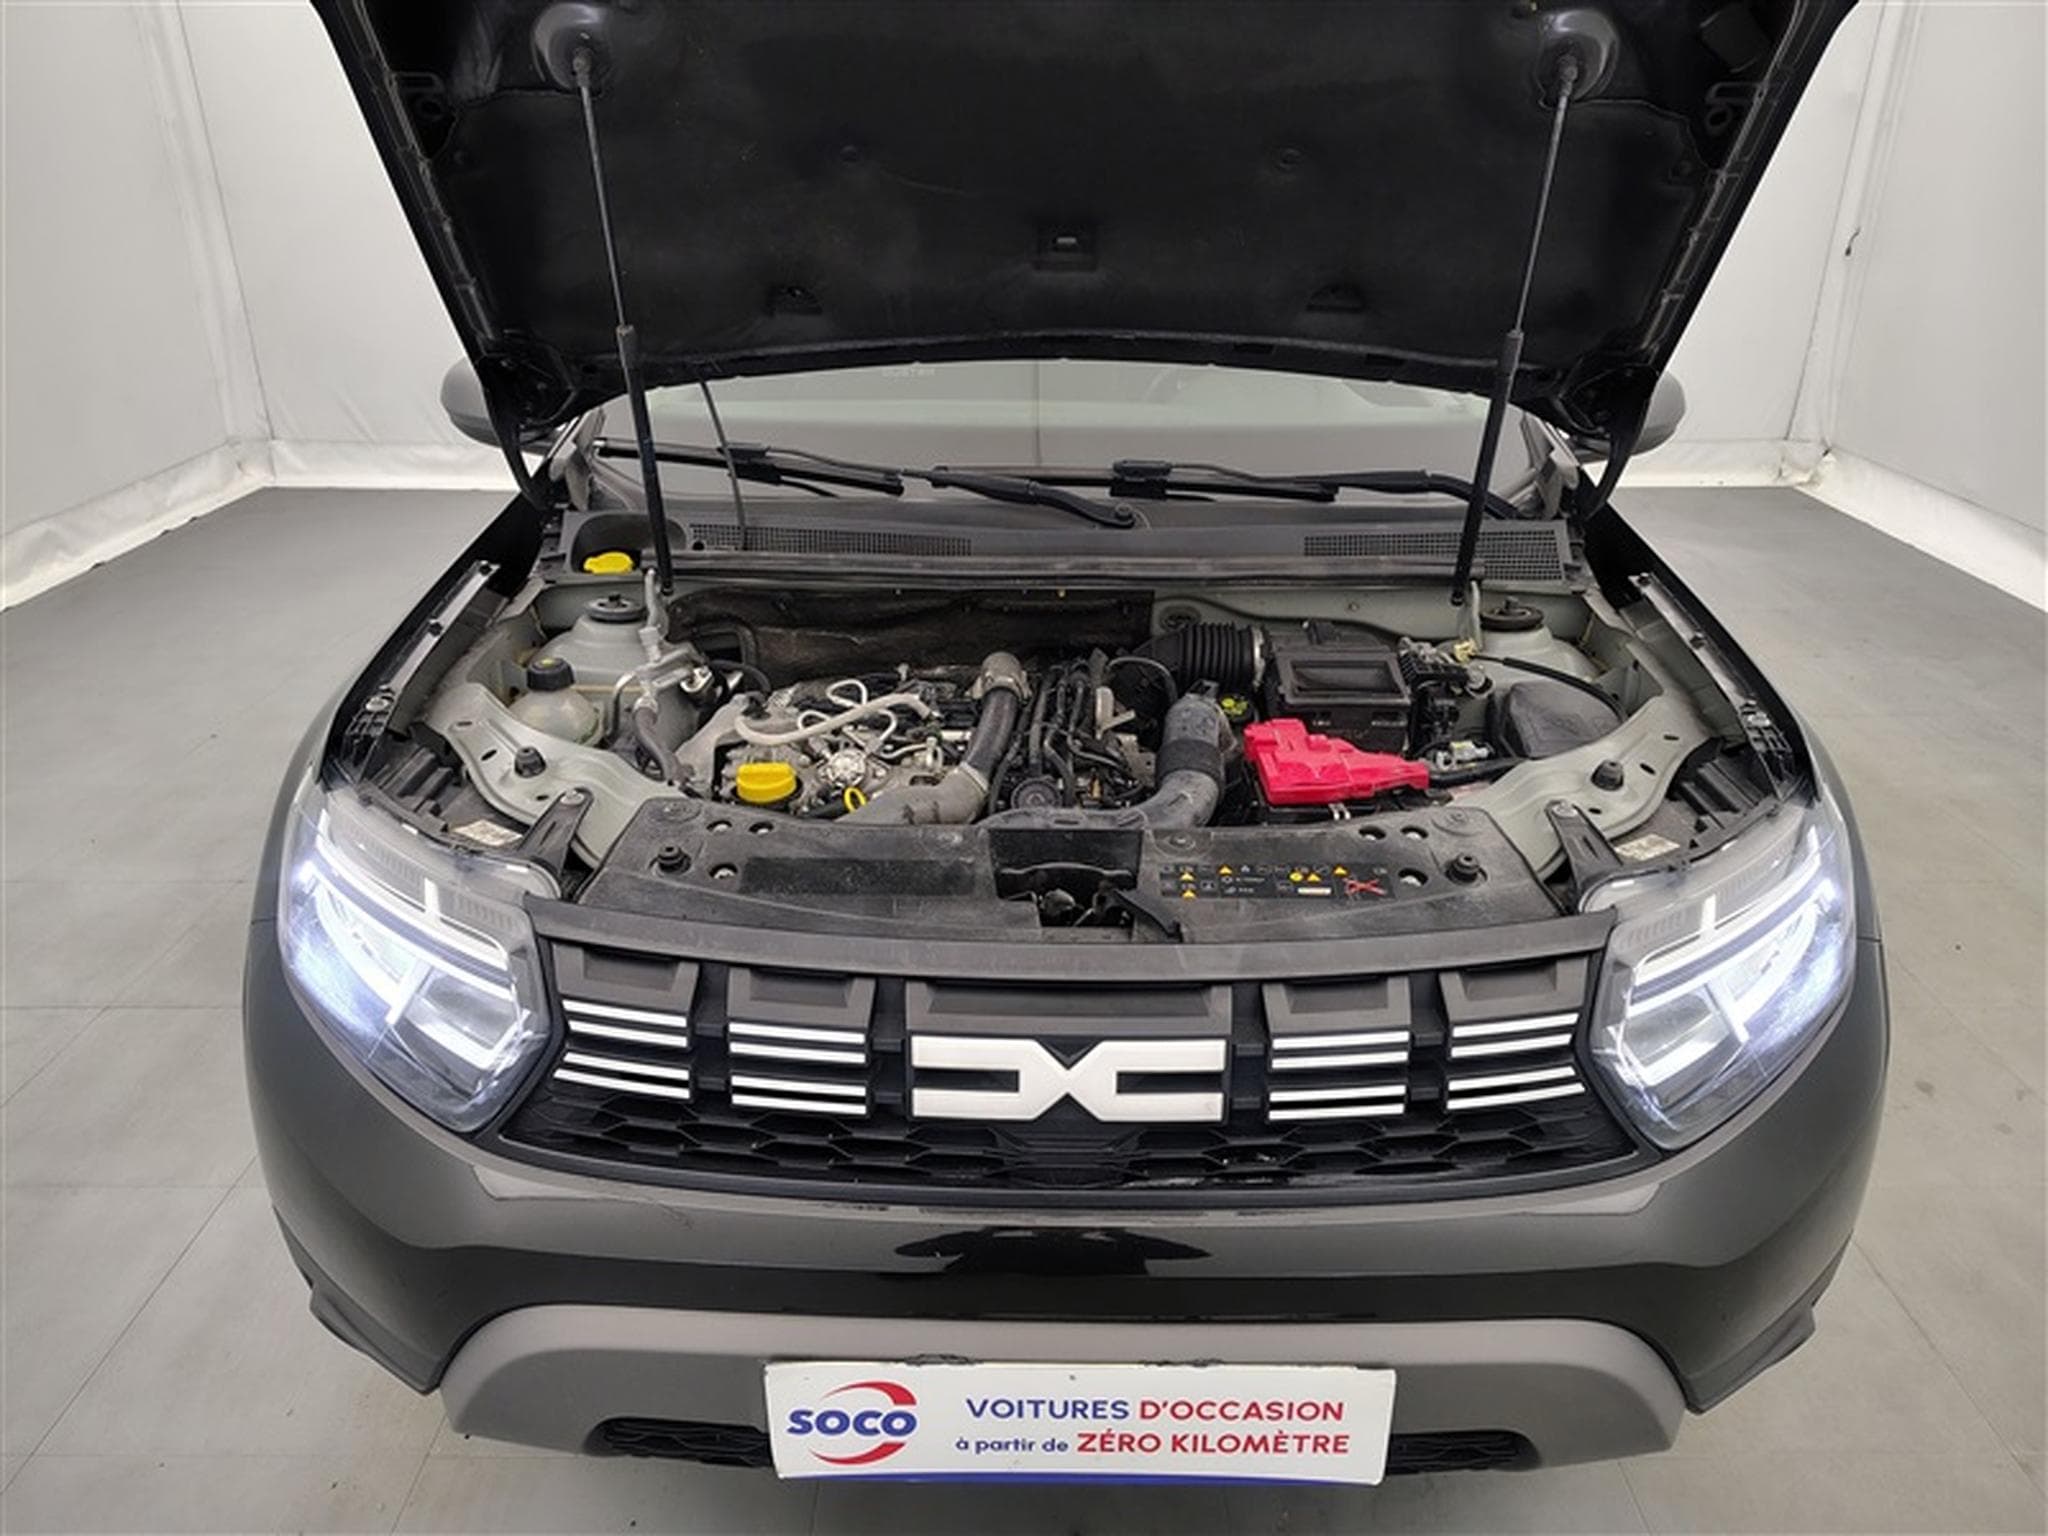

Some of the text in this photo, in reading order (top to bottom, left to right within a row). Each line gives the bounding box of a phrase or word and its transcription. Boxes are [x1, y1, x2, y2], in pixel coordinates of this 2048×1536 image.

[787, 1410, 917, 1436] SOCO
[966, 1398, 1345, 1422] VOITURES D'OCCASION
[955, 1428, 1349, 1456] à partir de ZÉRO KILOMÈTRE
